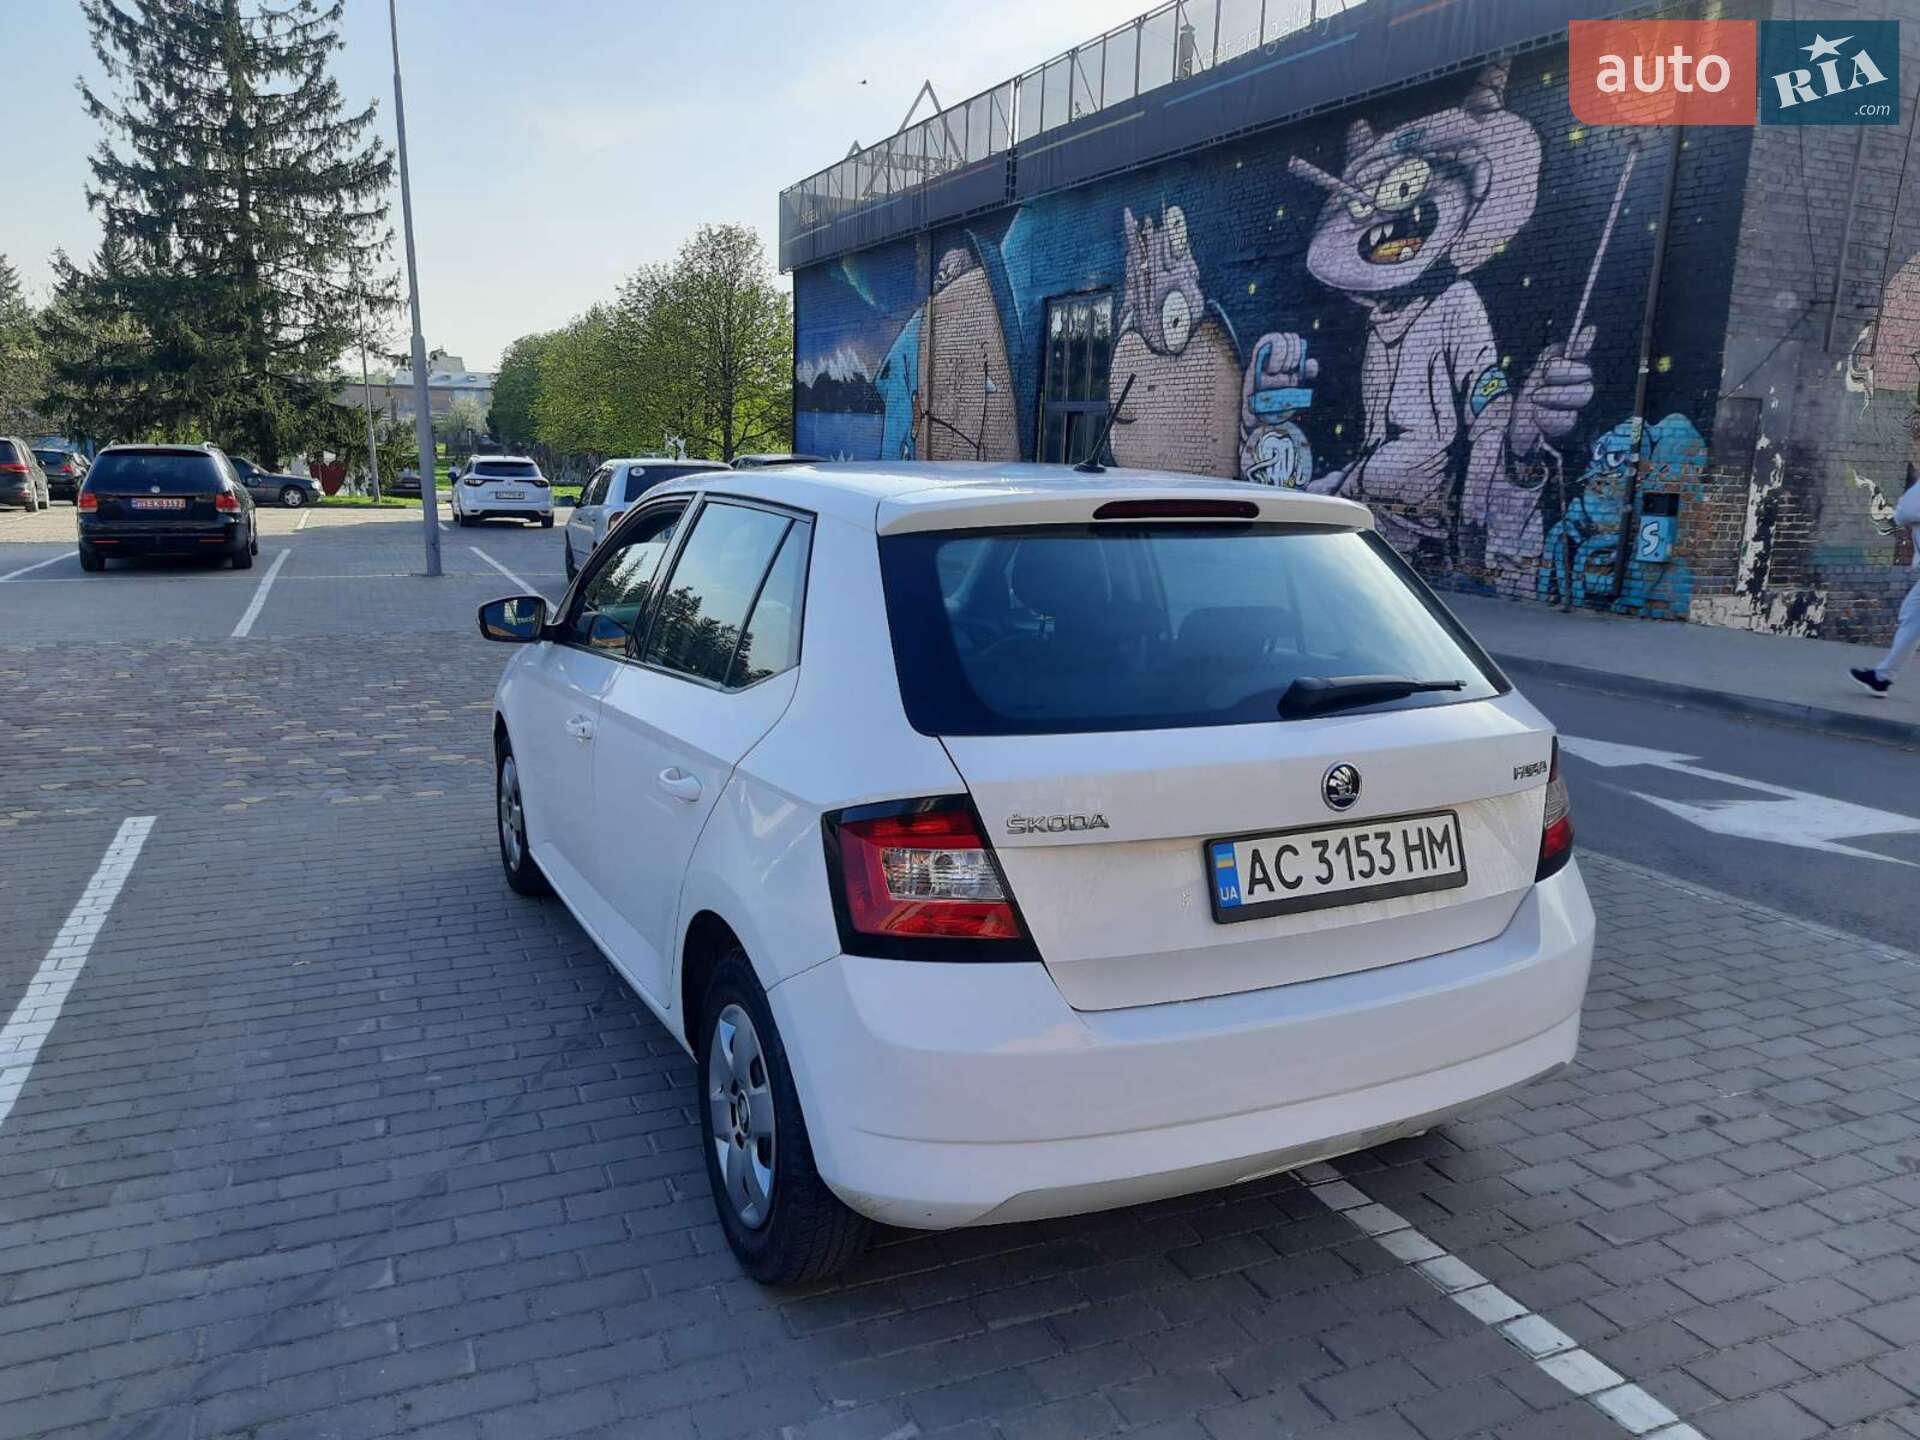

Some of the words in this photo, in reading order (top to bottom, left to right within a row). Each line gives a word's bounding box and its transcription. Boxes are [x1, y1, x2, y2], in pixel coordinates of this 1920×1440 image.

[1006, 813, 1110, 835] ŠKODA
[1248, 844, 1303, 895] AC
[1311, 831, 1396, 885] 3153
[1402, 824, 1455, 873] HM
[1220, 886, 1239, 901] UA
